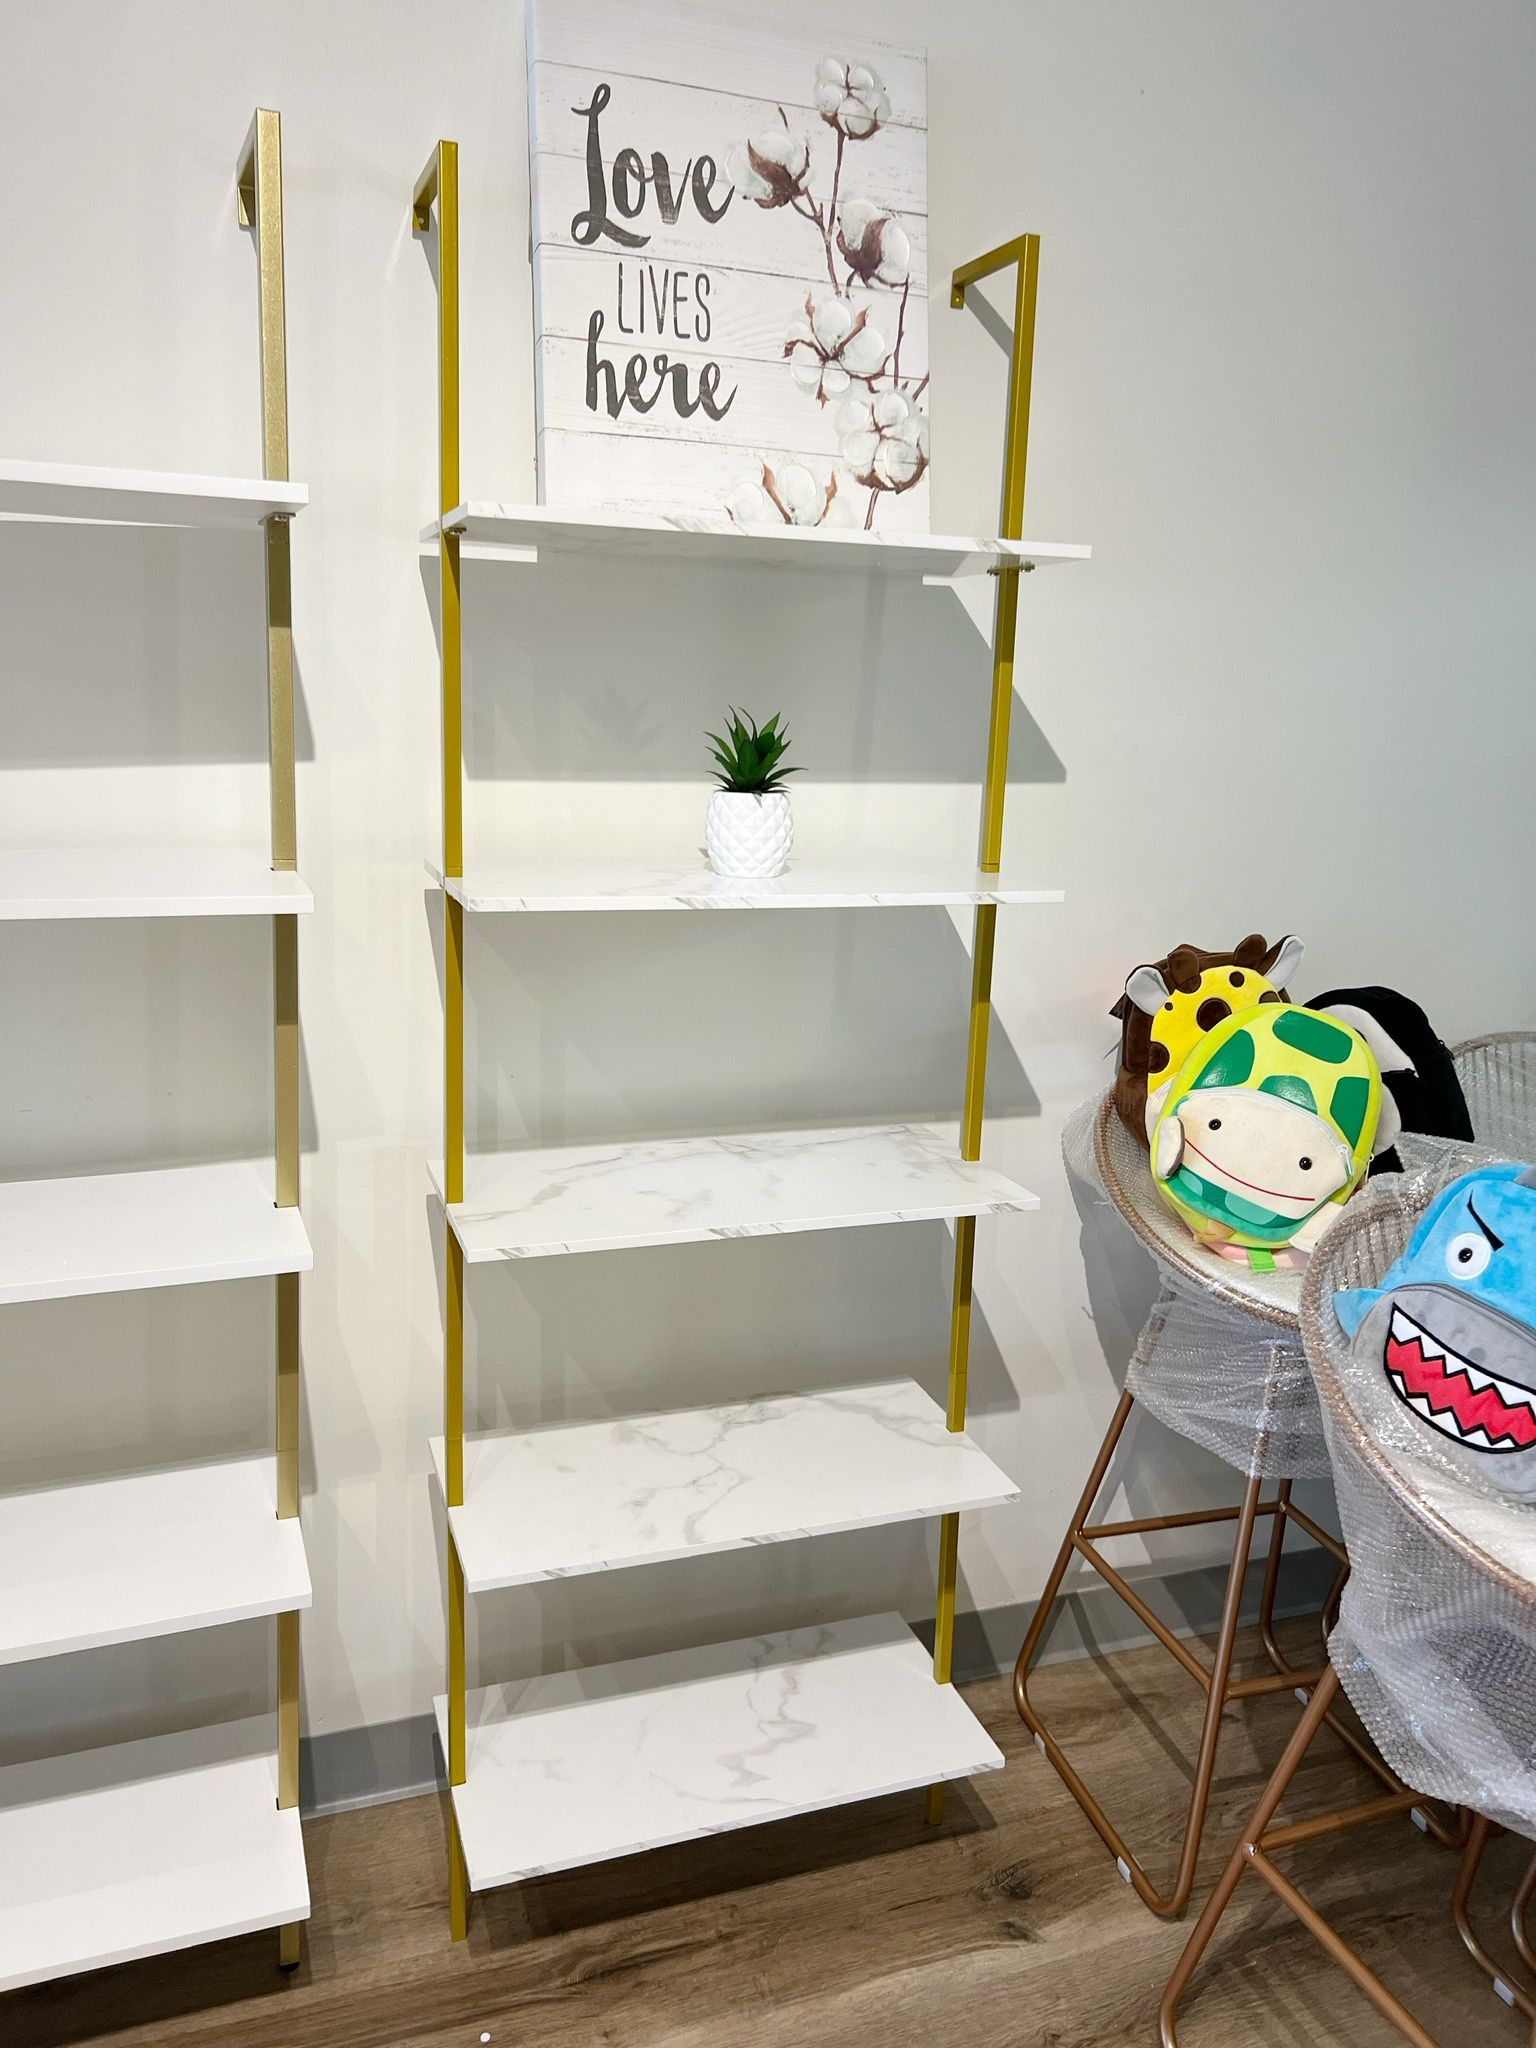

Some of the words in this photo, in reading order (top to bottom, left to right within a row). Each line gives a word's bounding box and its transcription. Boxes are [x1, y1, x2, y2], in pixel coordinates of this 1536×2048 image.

[571, 83, 735, 248] Love
[618, 261, 711, 343] LIVES
[585, 309, 738, 422] here
